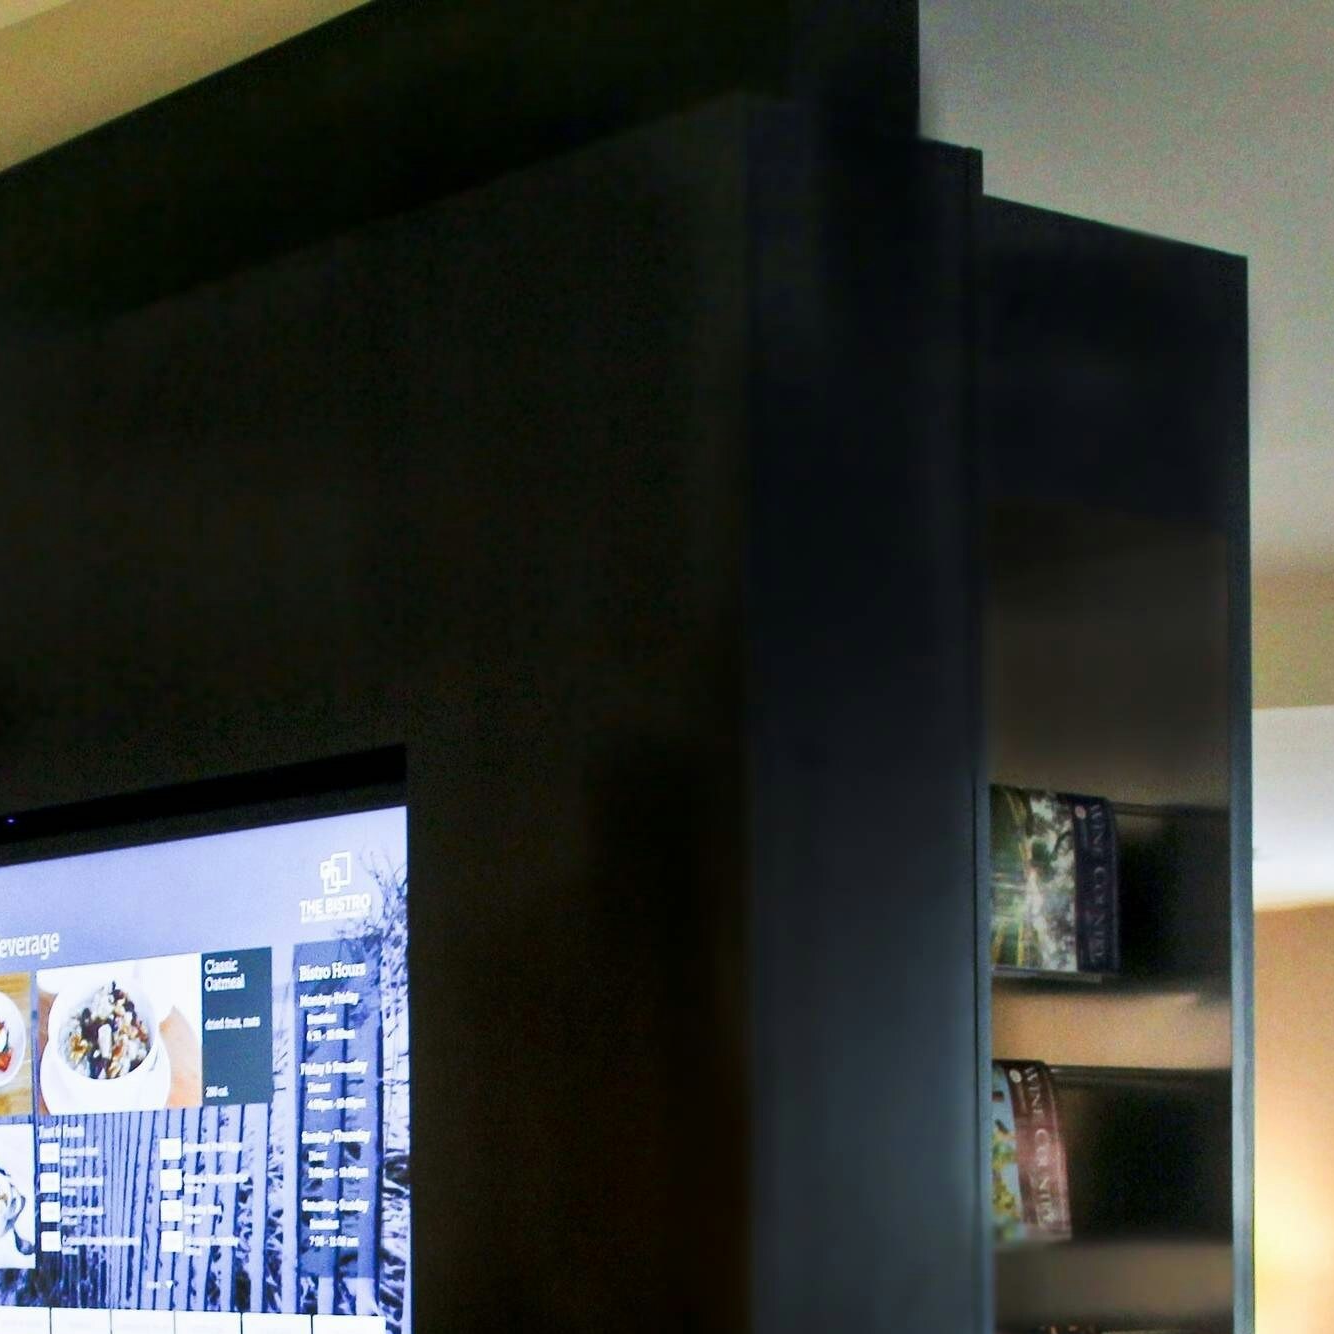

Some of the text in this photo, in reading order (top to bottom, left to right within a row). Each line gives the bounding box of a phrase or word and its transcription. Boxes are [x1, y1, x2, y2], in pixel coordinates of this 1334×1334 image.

[299, 893, 372, 915] THE BISTRO
[205, 957, 238, 974] Classic
[299, 962, 367, 982] Bistro Hours
[205, 973, 245, 992] Oatmeal
